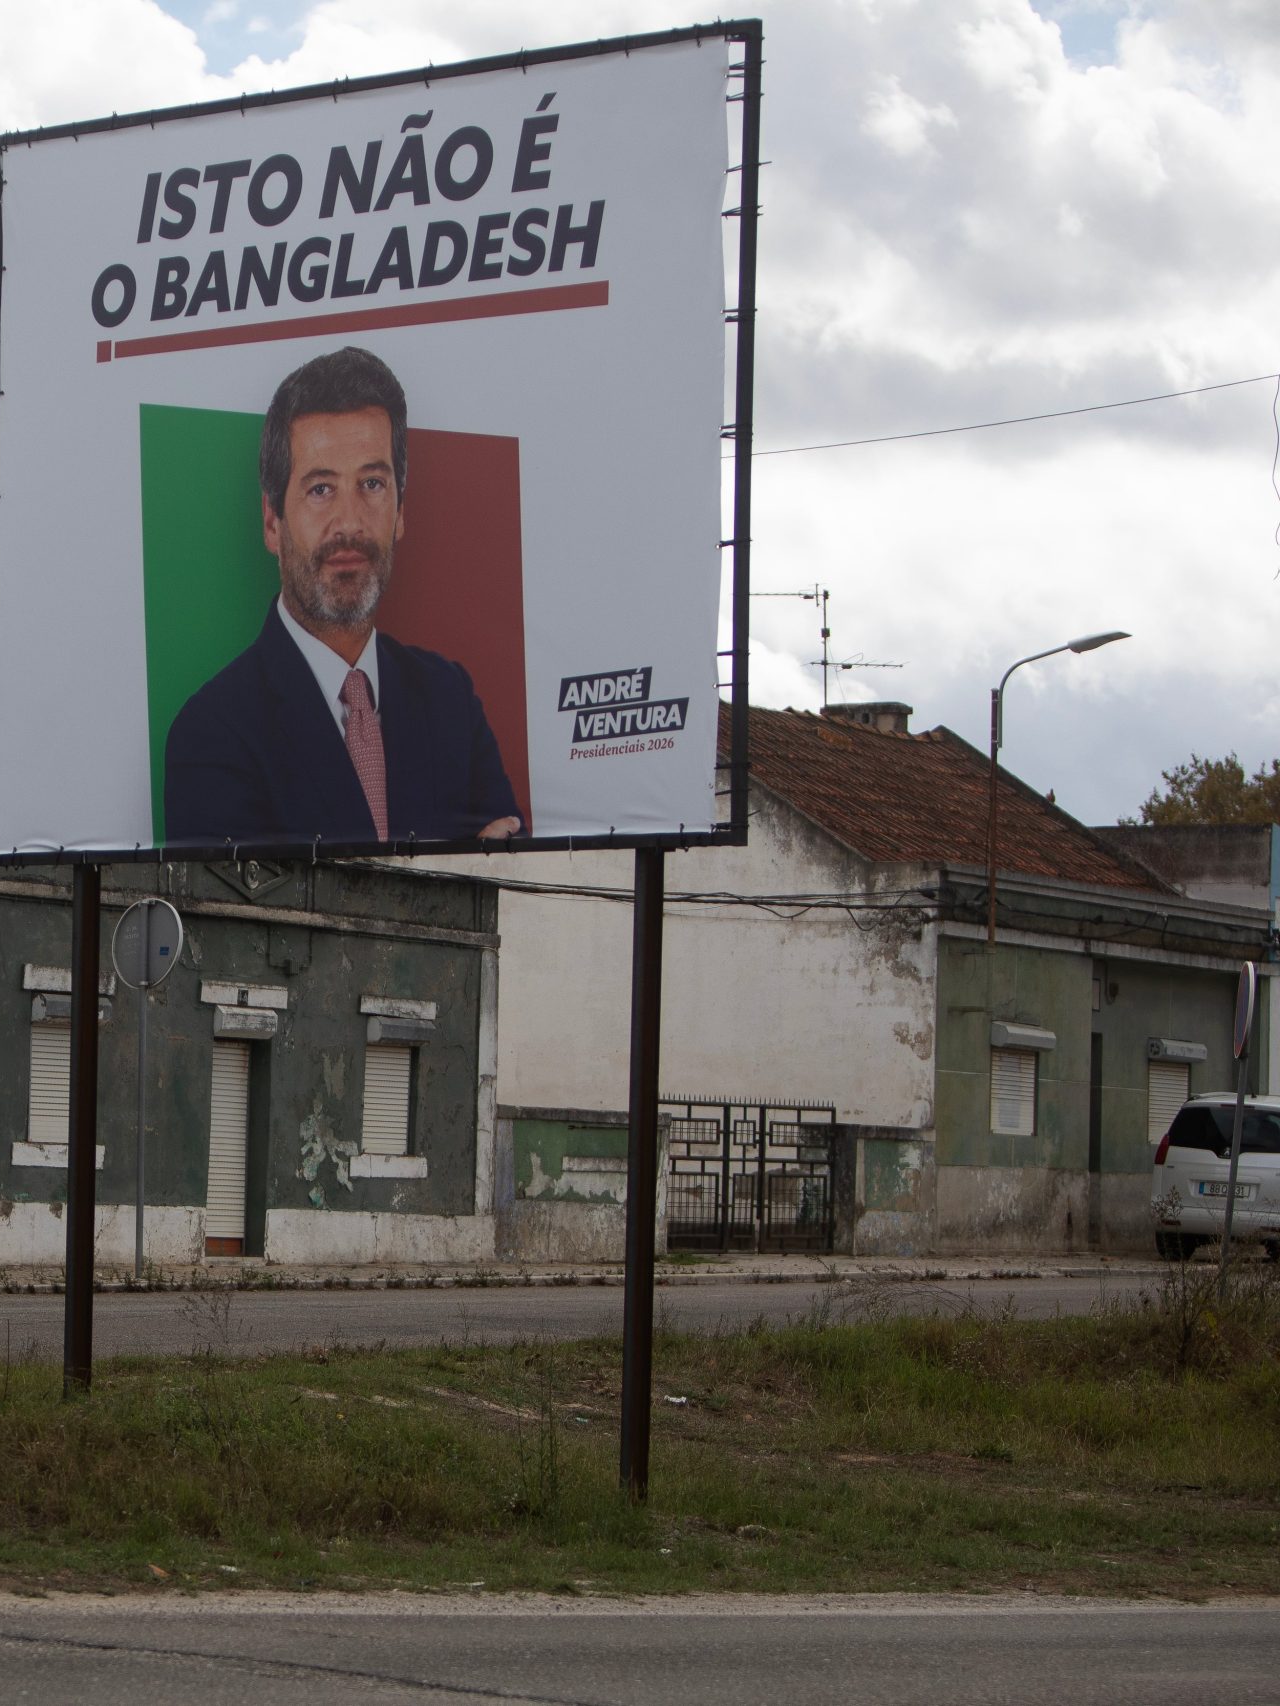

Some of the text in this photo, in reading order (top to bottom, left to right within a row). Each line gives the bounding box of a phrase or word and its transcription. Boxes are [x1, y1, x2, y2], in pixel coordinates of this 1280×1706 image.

[136, 92, 560, 244] ISTO NÃO É
[91, 199, 607, 328] O BANGLADESH
[562, 668, 644, 708] ANDRÉ
[577, 703, 683, 738] VENTURA
[569, 737, 675, 760] Presidenciais 2026
